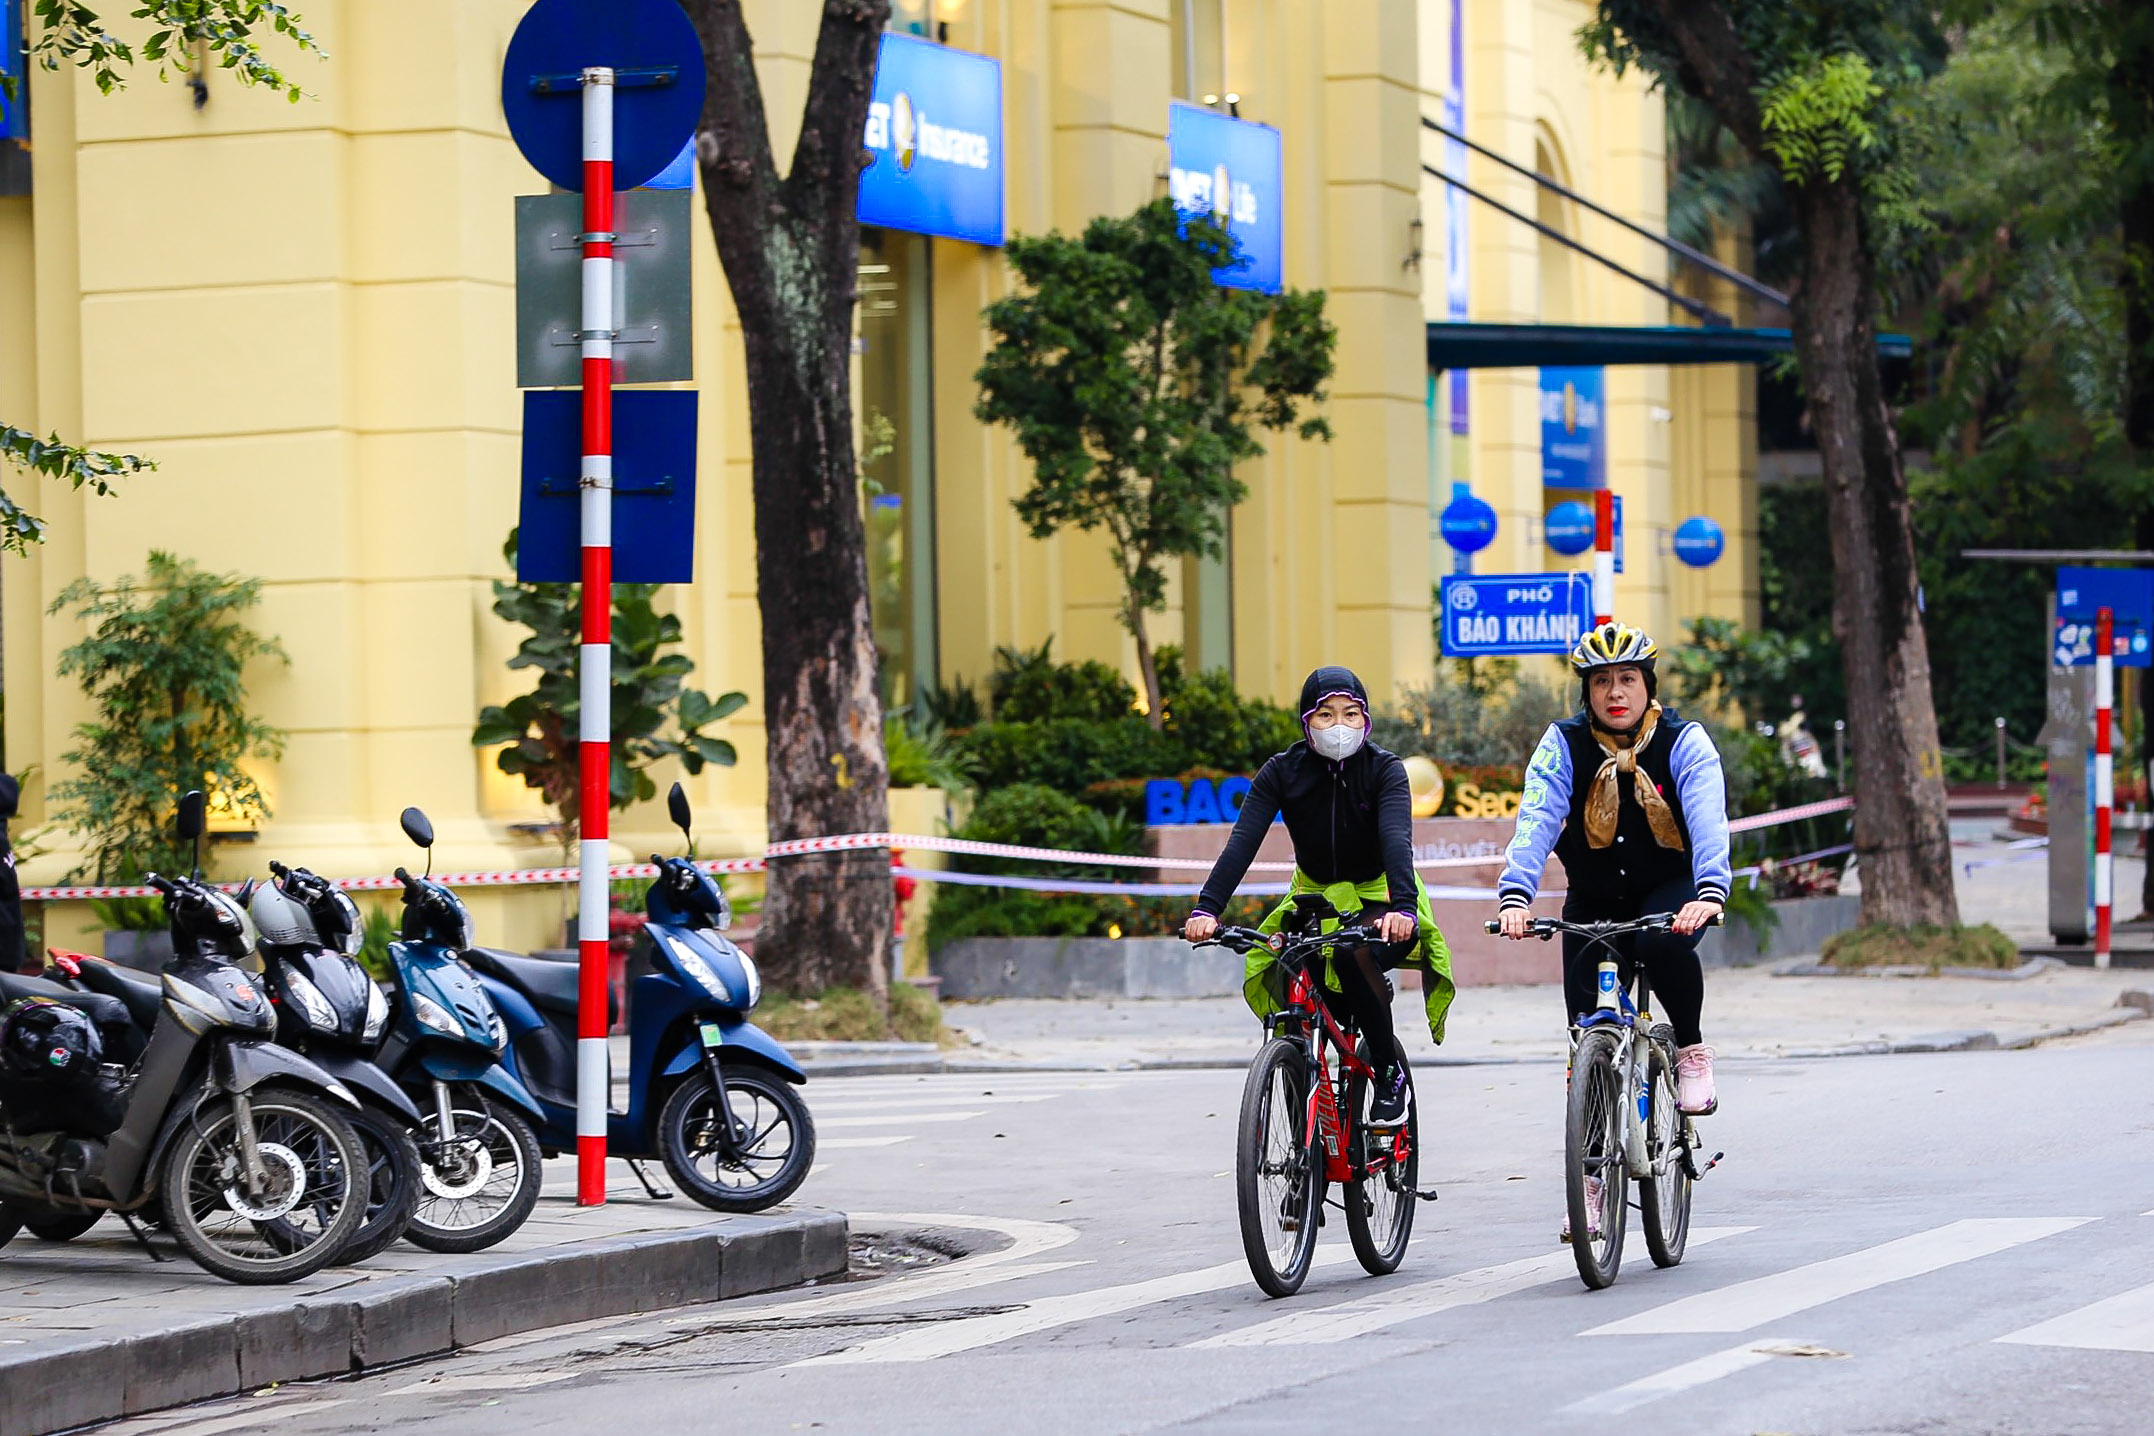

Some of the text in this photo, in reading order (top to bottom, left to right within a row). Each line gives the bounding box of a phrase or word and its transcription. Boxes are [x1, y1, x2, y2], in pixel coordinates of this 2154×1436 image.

[1507, 581, 1554, 604] PHỐ
[1506, 608, 1580, 642] KHÁNH
[1455, 783, 1523, 819] Sec
